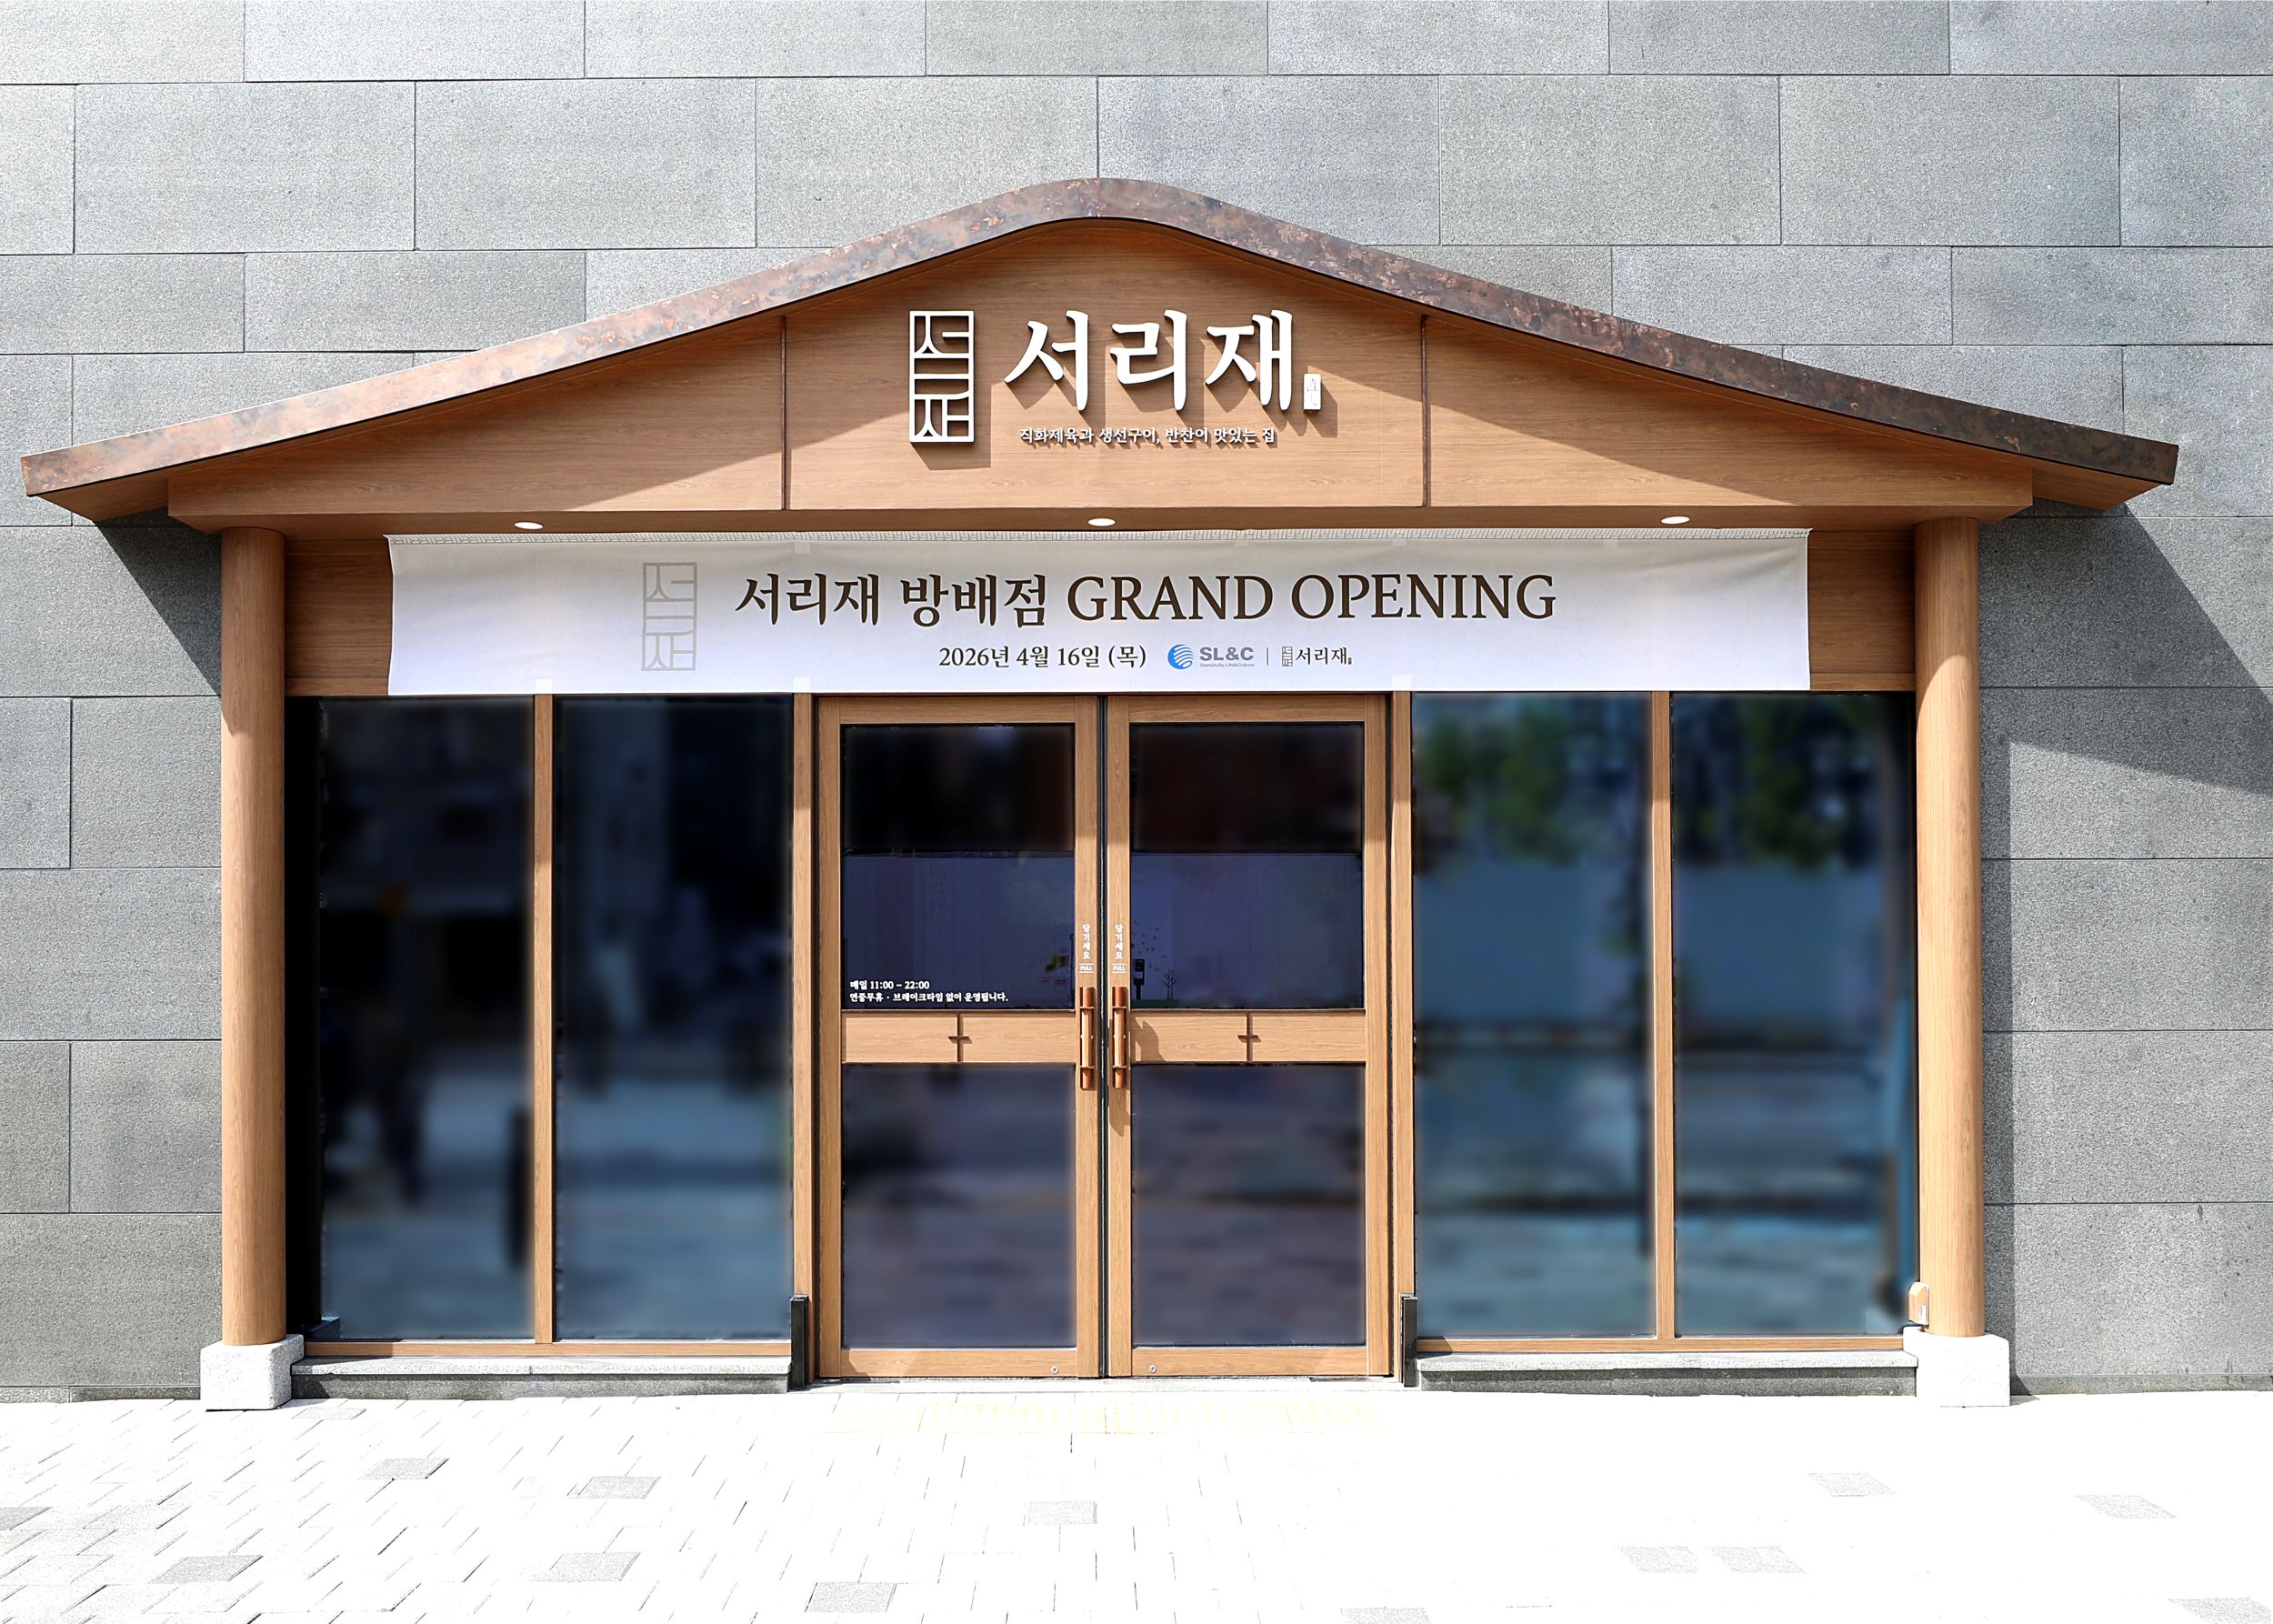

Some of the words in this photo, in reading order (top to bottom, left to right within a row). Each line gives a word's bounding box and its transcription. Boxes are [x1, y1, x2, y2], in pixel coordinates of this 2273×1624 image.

[1004, 309, 1293, 411] 서리재
[1019, 427, 1094, 444] 직화제육과
[1098, 427, 1160, 444] 생선구이,
[1165, 427, 1208, 443] 반찬이
[1214, 427, 1257, 443] 맛있는
[1262, 427, 1275, 443] 집
[736, 573, 879, 626] 서리재
[900, 574, 1046, 627] 방배점
[1067, 575, 1273, 621] GRAND
[1291, 573, 1557, 619] OPENING
[938, 646, 1009, 668] 2026년
[1016, 646, 1049, 668] 4월
[1057, 646, 1100, 668] 16일
[1108, 645, 1147, 668] (목)
[1199, 647, 1254, 661] SL&C
[1295, 647, 1347, 666] 서리재
[850, 980, 867, 989] 매일
[870, 980, 895, 989] 11:00
[904, 980, 930, 989] 22:00
[849, 992, 884, 1002] 연중무휴
[893, 992, 944, 1002] 브레이크타임
[946, 992, 962, 1002] 없이
[964, 992, 1008, 1002] 운영됩니다.
